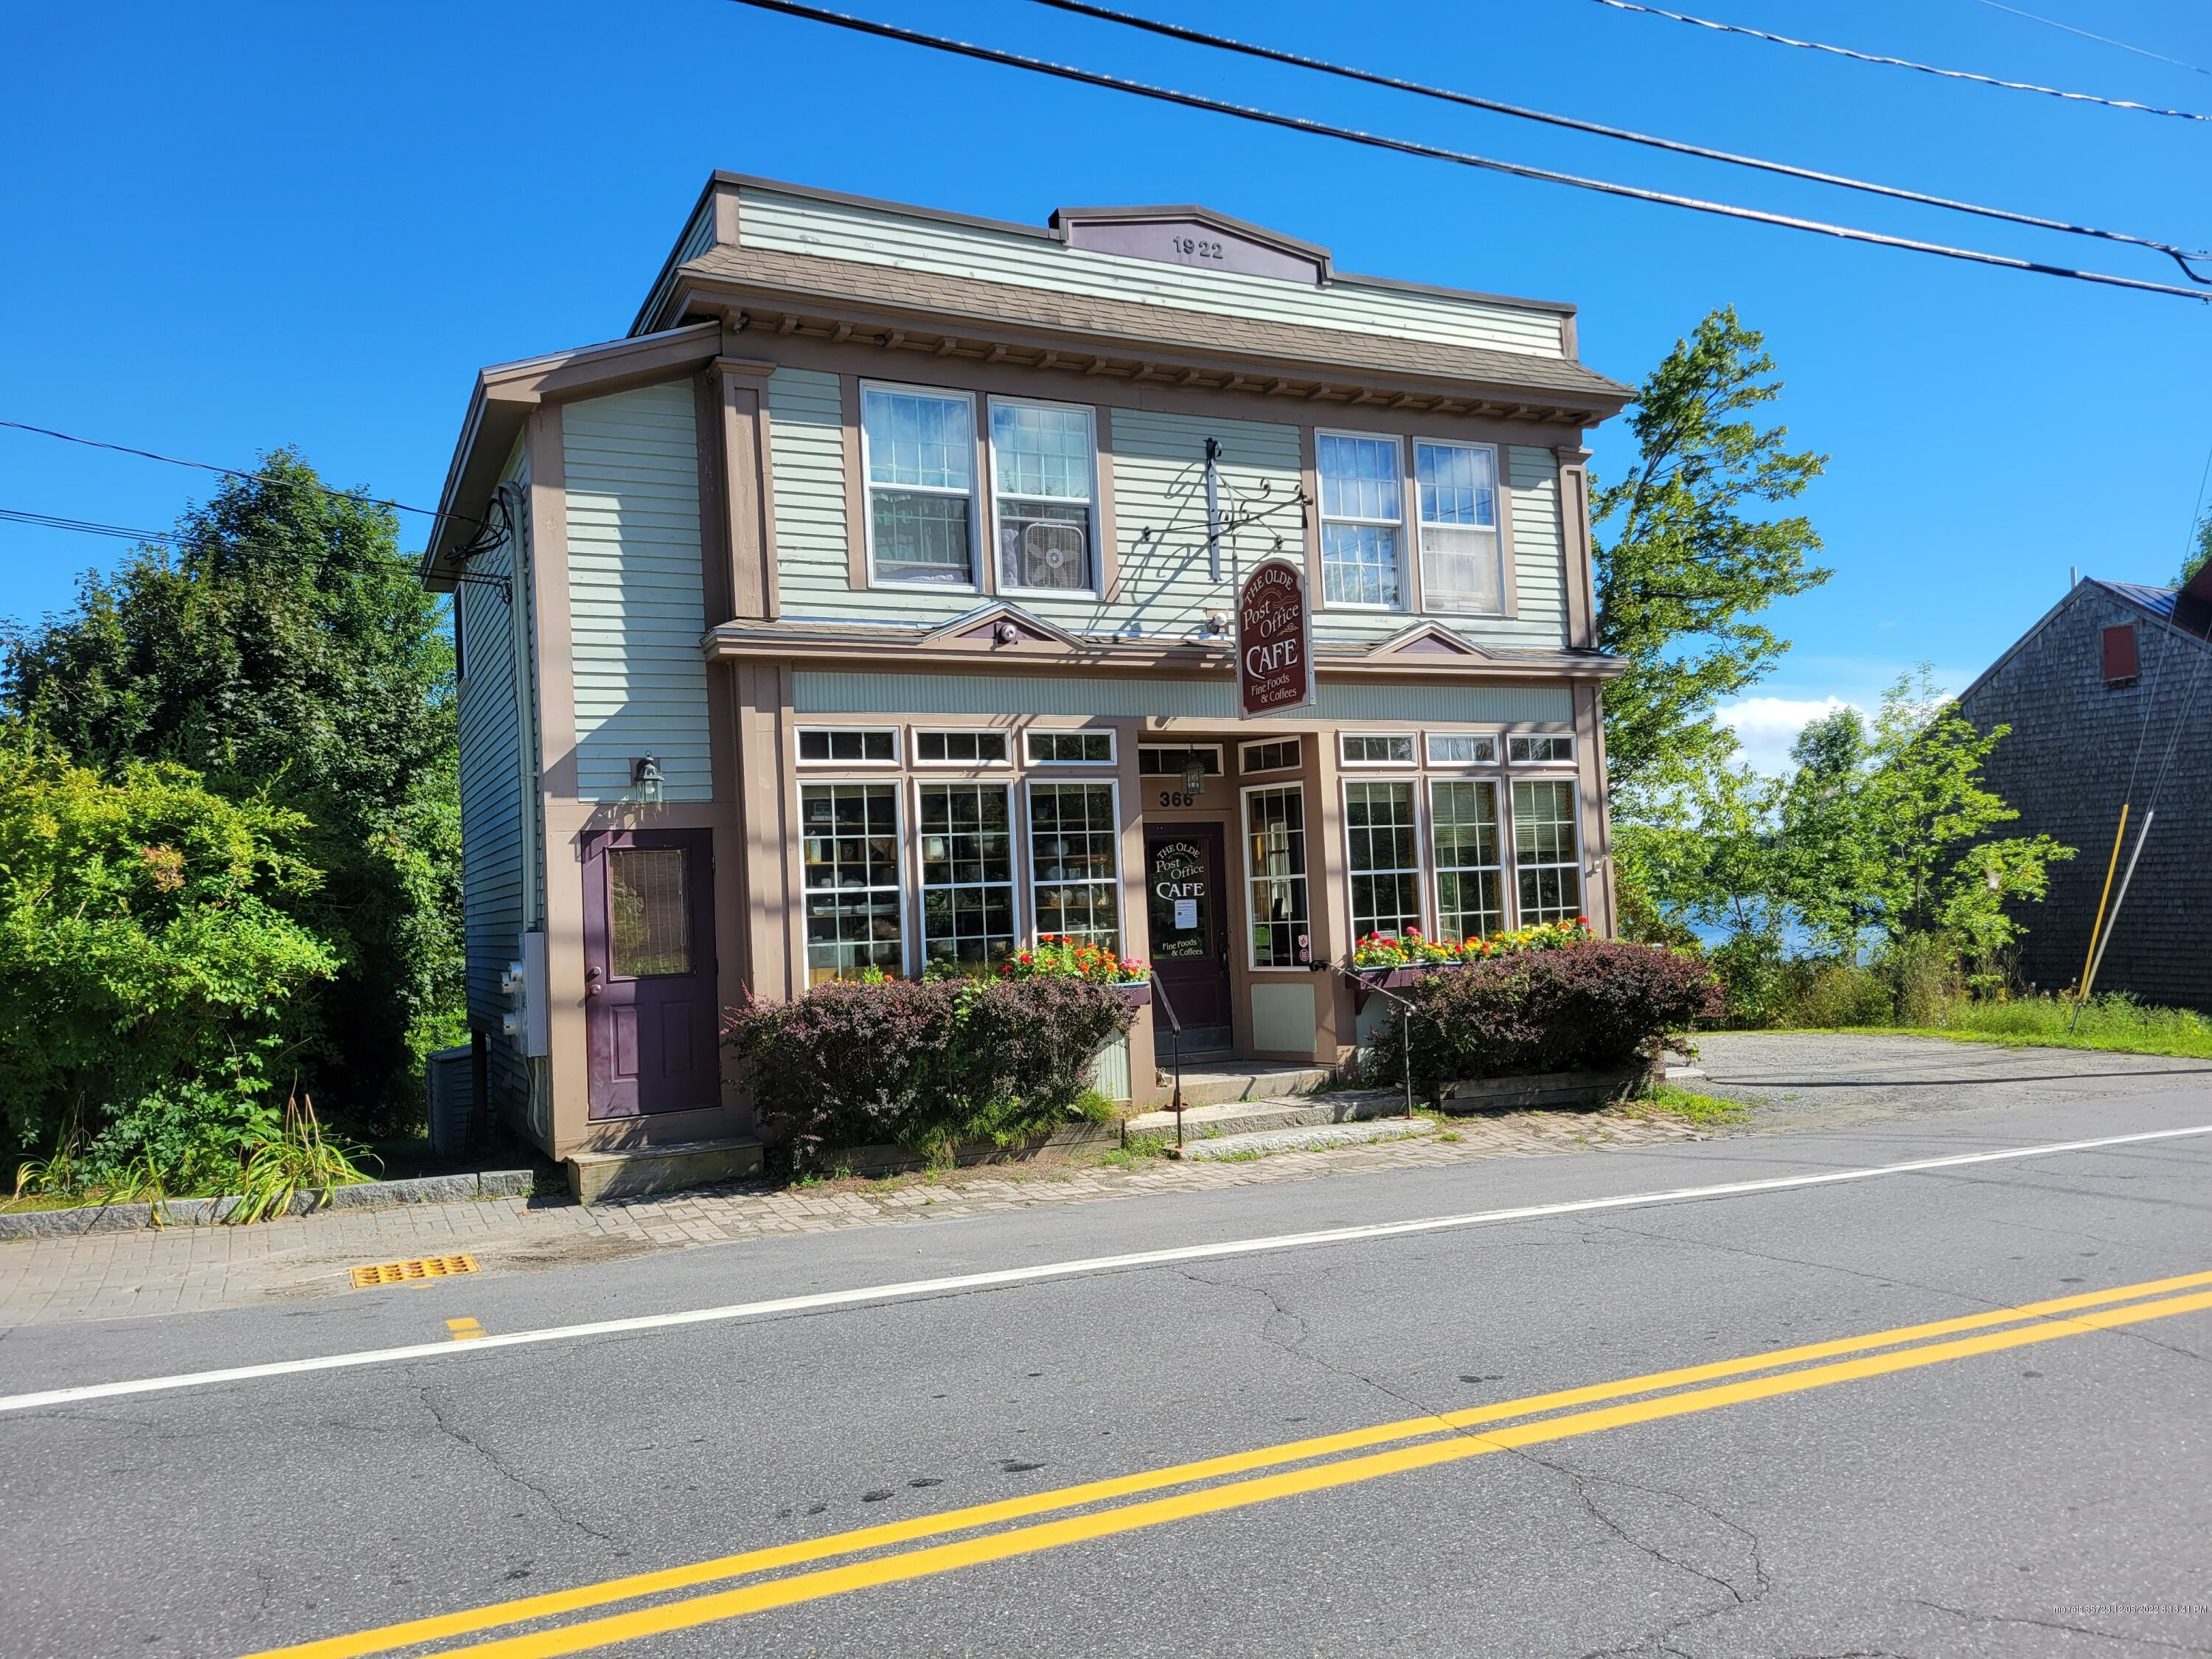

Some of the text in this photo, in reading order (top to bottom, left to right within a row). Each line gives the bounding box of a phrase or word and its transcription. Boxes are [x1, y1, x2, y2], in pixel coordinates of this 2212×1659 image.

[1173, 236, 1223, 259] 1922
[1245, 576, 1265, 605] THE
[1265, 569, 1293, 590] OLDE
[1243, 599, 1270, 632] Post
[1260, 605, 1299, 638] Office
[1246, 638, 1298, 680] CAFE
[1251, 673, 1290, 696] Fine Foods
[1261, 688, 1297, 703] & Coffees
[1160, 791, 1193, 807] 366
[1157, 844, 1175, 859] THE
[1176, 842, 1200, 858] OLDE
[1155, 858, 1180, 873] Post
[1171, 864, 1205, 880] Office
[1156, 882, 1206, 901] CAFE
[1162, 939, 1197, 950] Fine Foods
[1179, 948, 1203, 956] Coffees
